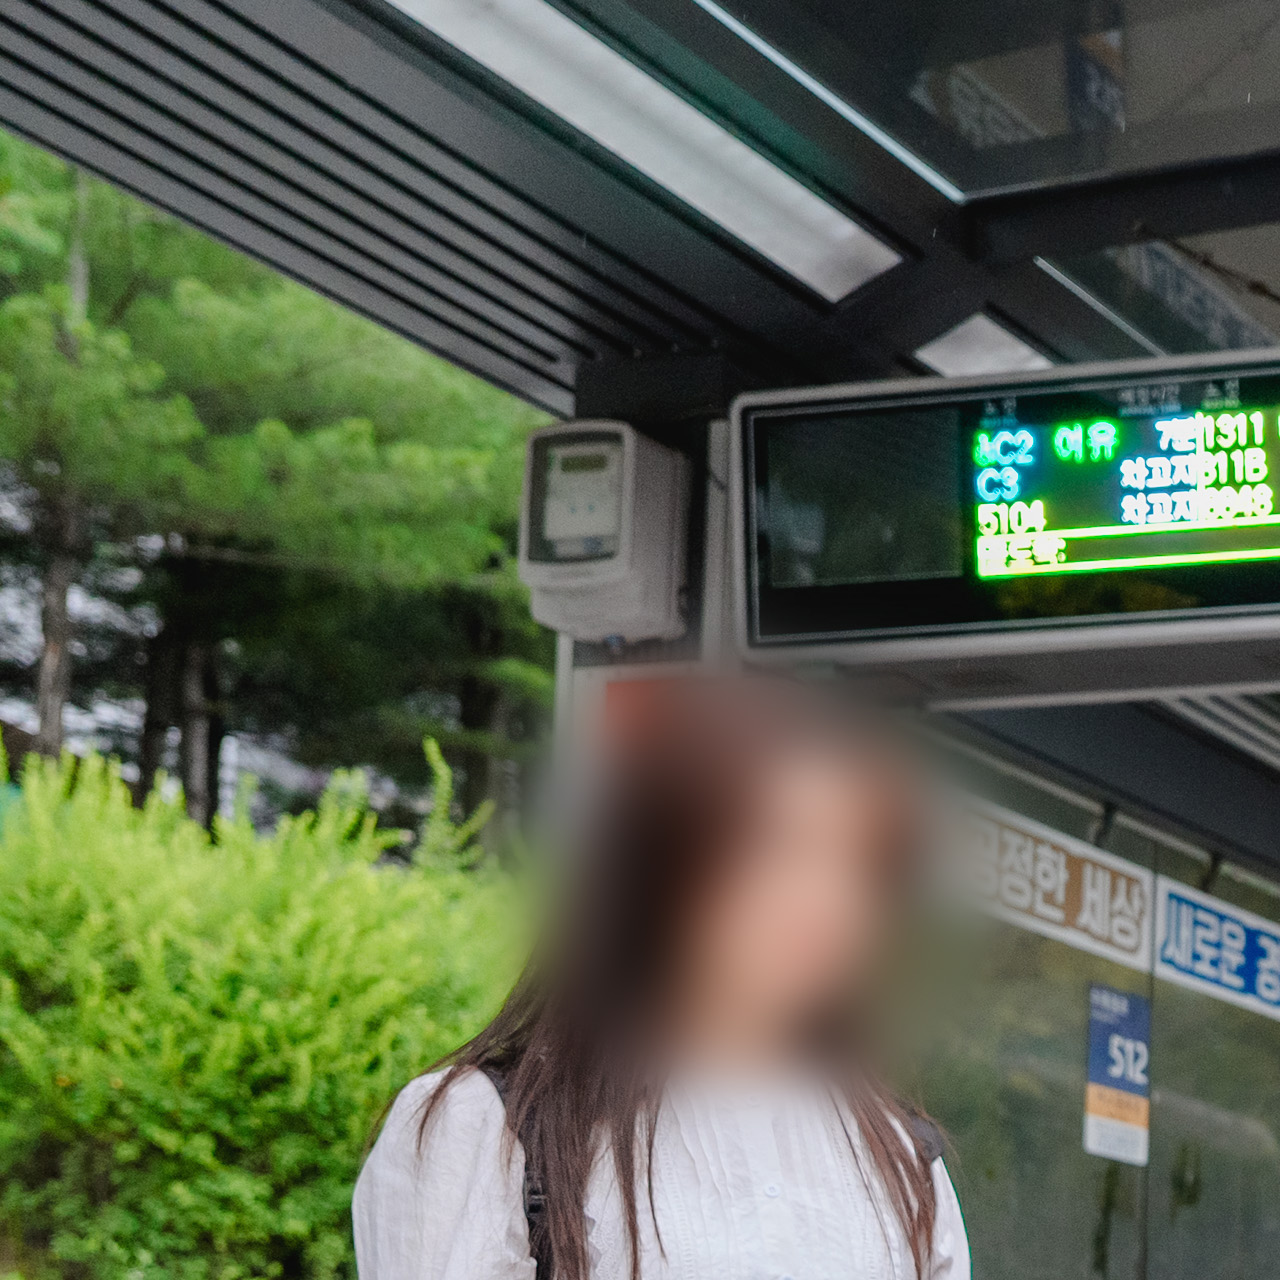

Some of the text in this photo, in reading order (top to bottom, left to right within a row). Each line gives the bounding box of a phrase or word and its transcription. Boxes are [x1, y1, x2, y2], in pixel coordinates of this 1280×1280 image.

[976, 453, 1197, 501] C3 차고지
[976, 490, 1197, 535] 5104 차고지
[1076, 861, 1143, 948] 세상
[1162, 899, 1247, 990] 새로운
[1108, 1032, 1149, 1086] 512
